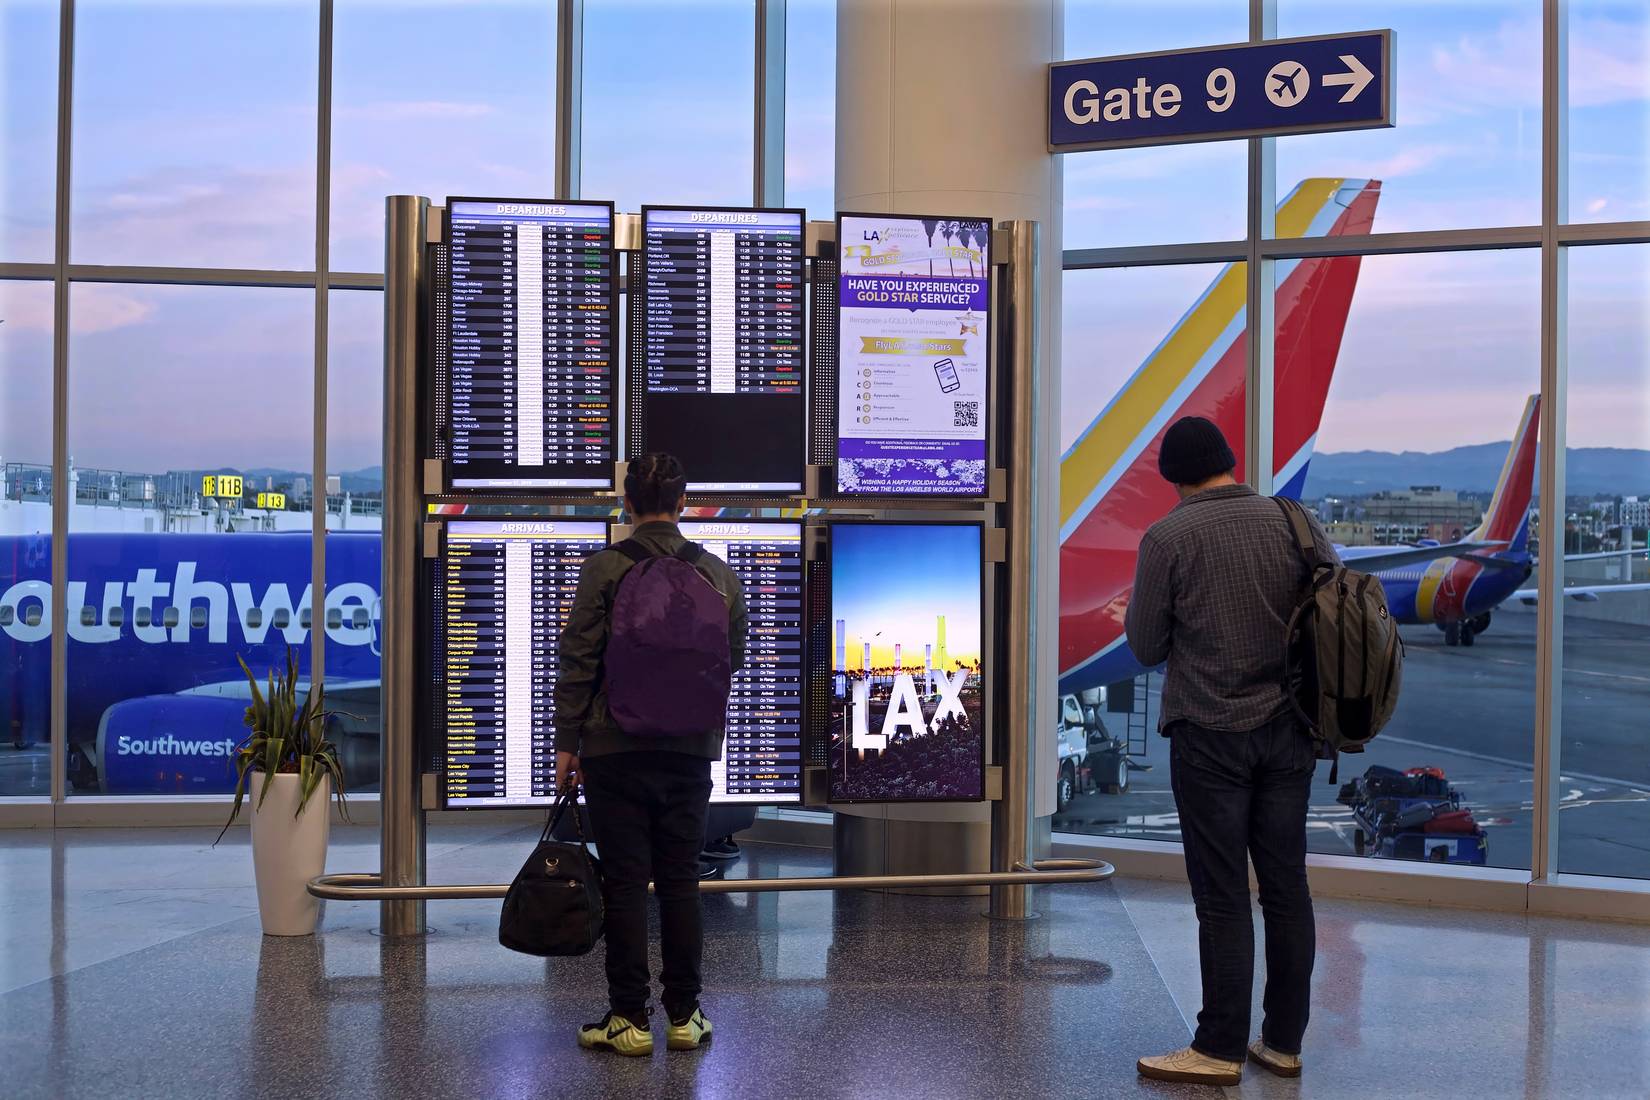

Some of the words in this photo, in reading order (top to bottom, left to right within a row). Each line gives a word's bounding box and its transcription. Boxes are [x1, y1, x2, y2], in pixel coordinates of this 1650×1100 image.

[1063, 77, 1182, 125] Gate
[1205, 67, 1236, 113] 9
[497, 205, 566, 215] DEPARTURES
[691, 213, 758, 223] DEPARTURES
[848, 280, 878, 290] HAVE
[880, 280, 902, 291] YOU
[906, 281, 980, 294] EXPERIENCED
[857, 292, 888, 302] GOLD
[892, 292, 918, 303] STAR
[921, 294, 970, 304] SERVICE?
[929, 342, 951, 351] Stars
[220, 478, 241, 495] 11B
[272, 496, 282, 508] 13
[501, 524, 554, 533] ARRIVALS
[699, 524, 750, 534] ARRIVALS
[852, 668, 970, 755] LAX
[117, 735, 234, 756] Southwest
